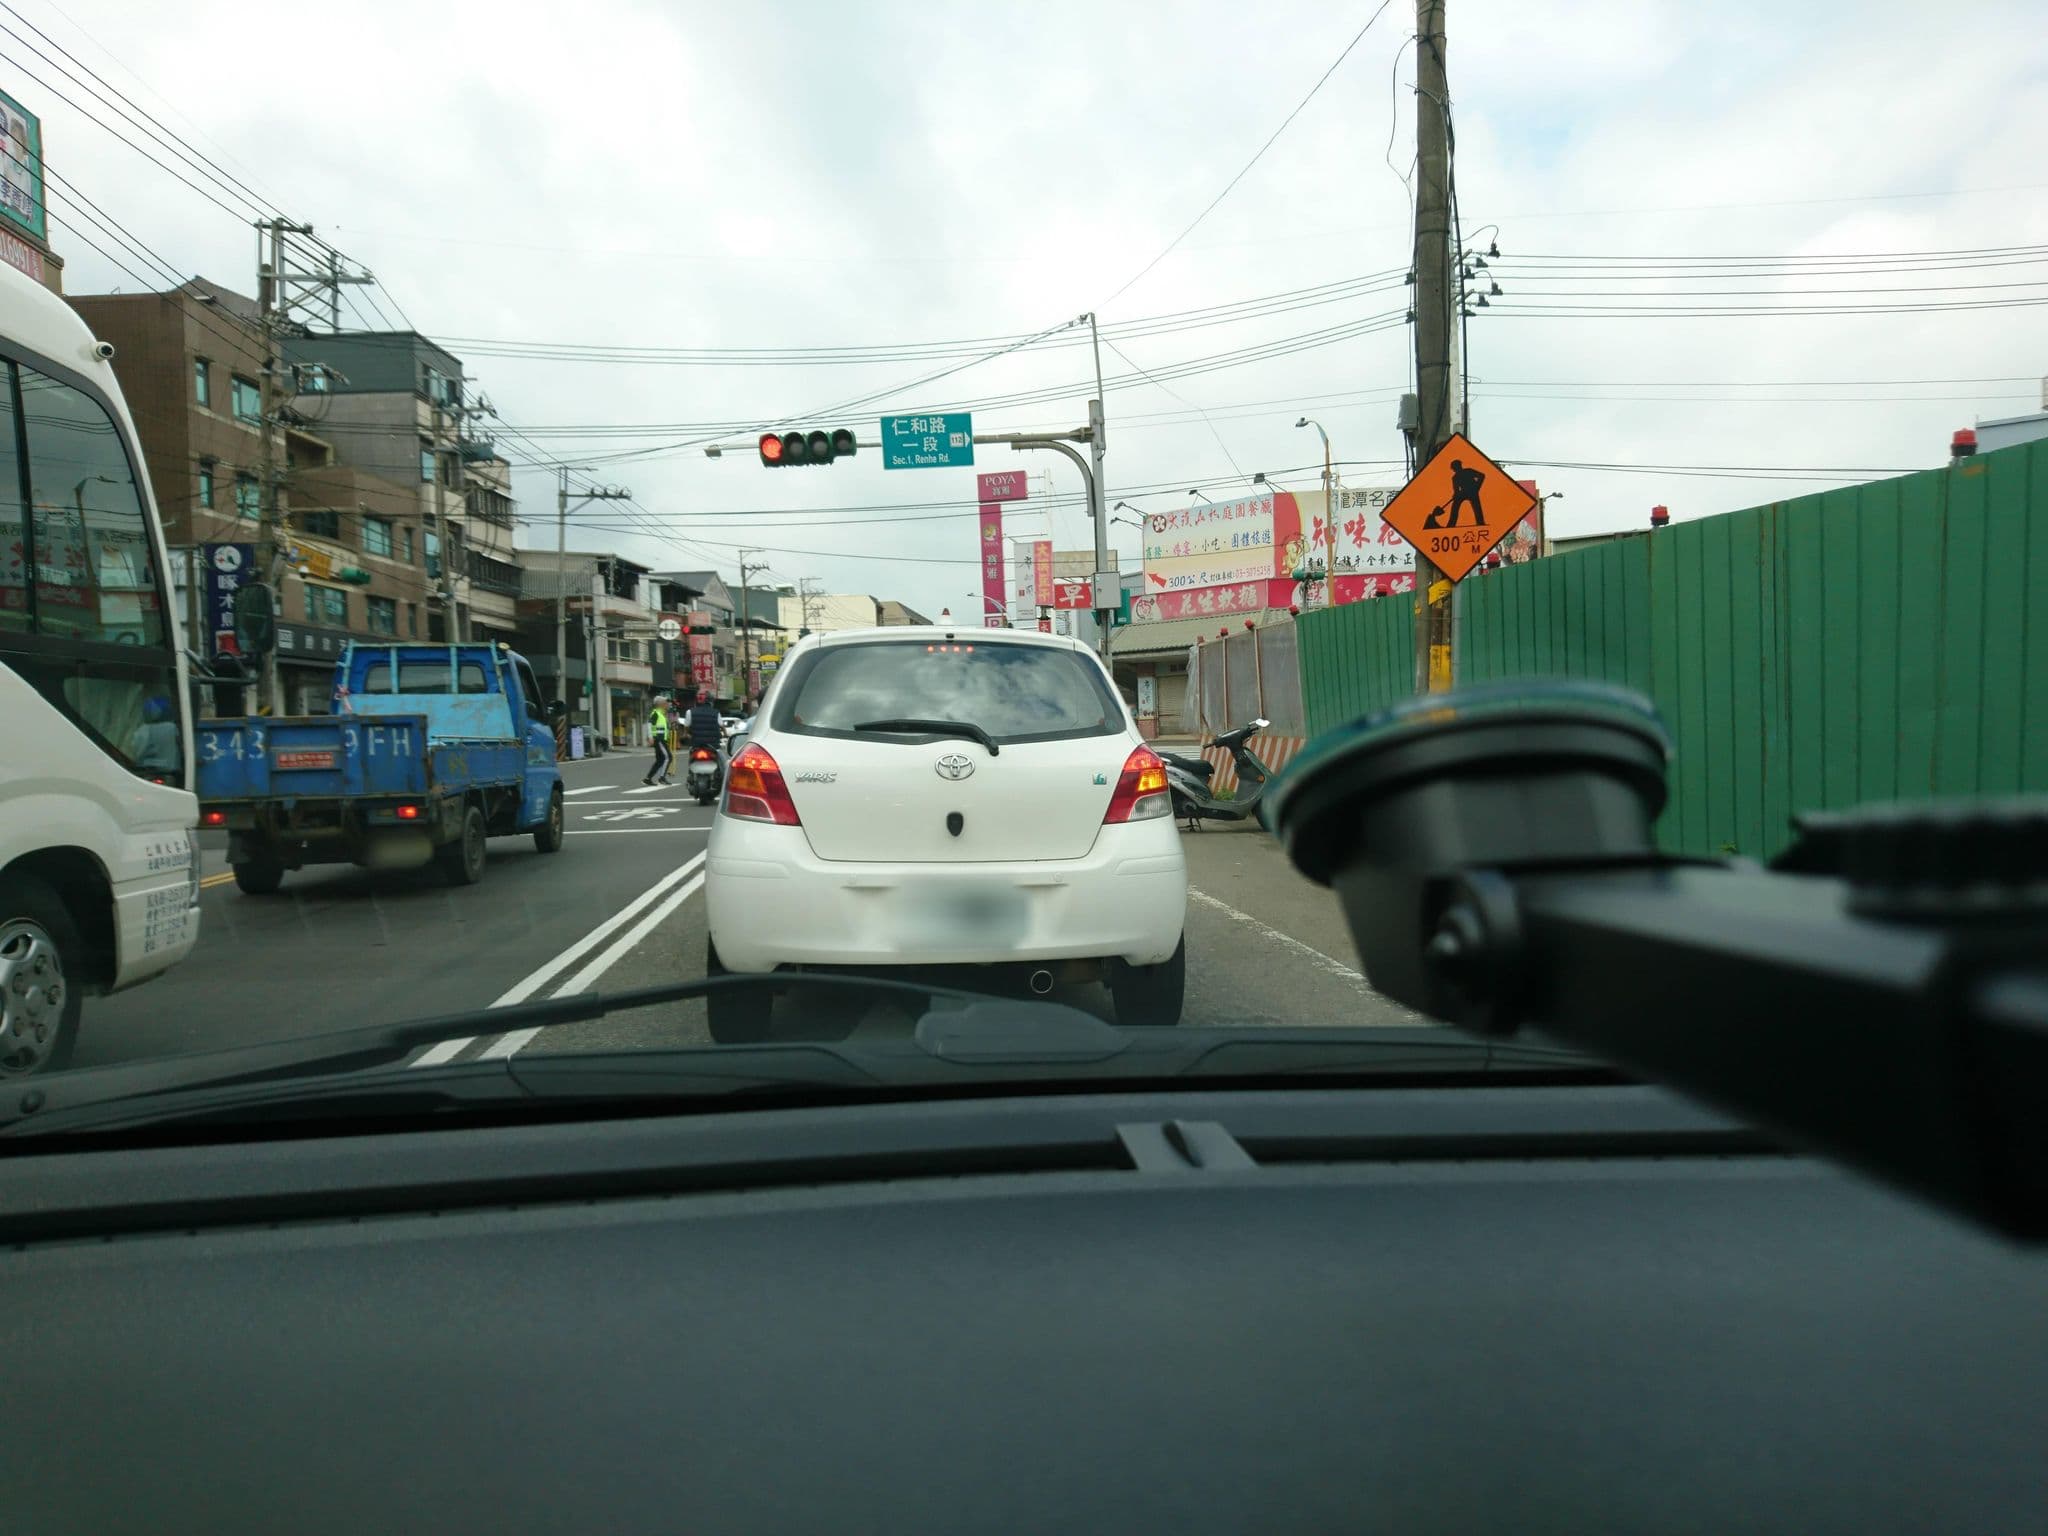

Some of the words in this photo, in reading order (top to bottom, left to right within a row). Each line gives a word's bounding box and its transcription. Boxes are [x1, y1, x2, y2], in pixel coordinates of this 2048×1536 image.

[892, 417, 945, 435] 仁和路
[902, 437, 937, 452] 一段
[892, 456, 914, 465] Sec.1,
[915, 455, 937, 464] Renhe
[938, 453, 950, 463] Rd.
[985, 475, 1016, 486] POYA
[1431, 536, 1460, 552] 300
[1463, 530, 1490, 543] 公尺
[1472, 545, 1481, 554] M
[1058, 584, 1092, 607] 早
[1180, 584, 1257, 615] 花生軟糖
